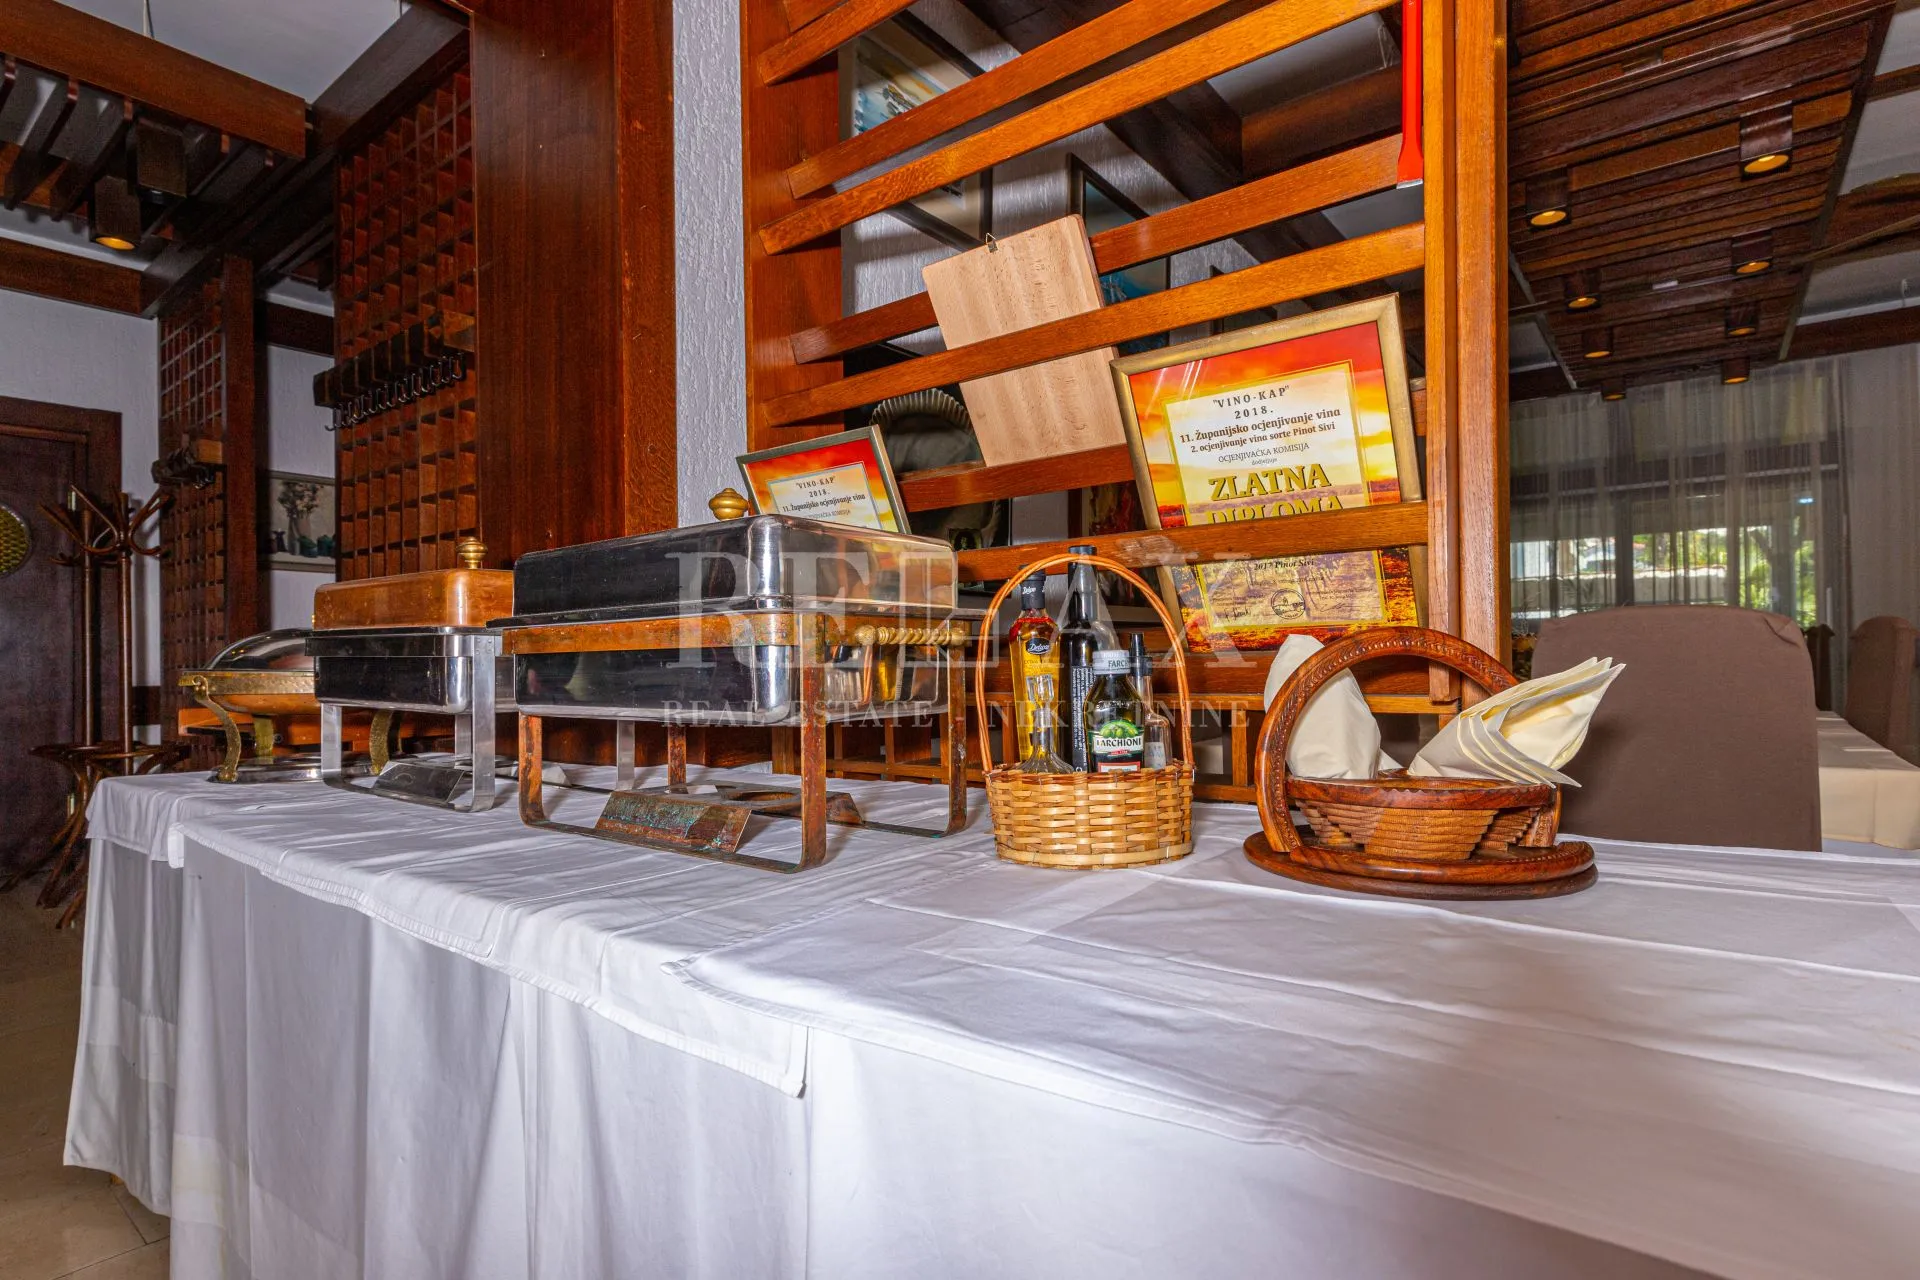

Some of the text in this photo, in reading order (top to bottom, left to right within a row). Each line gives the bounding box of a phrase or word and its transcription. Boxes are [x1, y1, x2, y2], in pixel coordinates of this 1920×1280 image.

[1180, 408, 1341, 443] 11. Županijsko ocjenjivanje vina
[1235, 405, 1274, 419] 2018.
[1191, 421, 1335, 453] 2. ocjenjivanje vina sorte Pinot Sivi
[1273, 442, 1310, 455] KOMISIJA
[1208, 463, 1332, 501] ZLATNA
